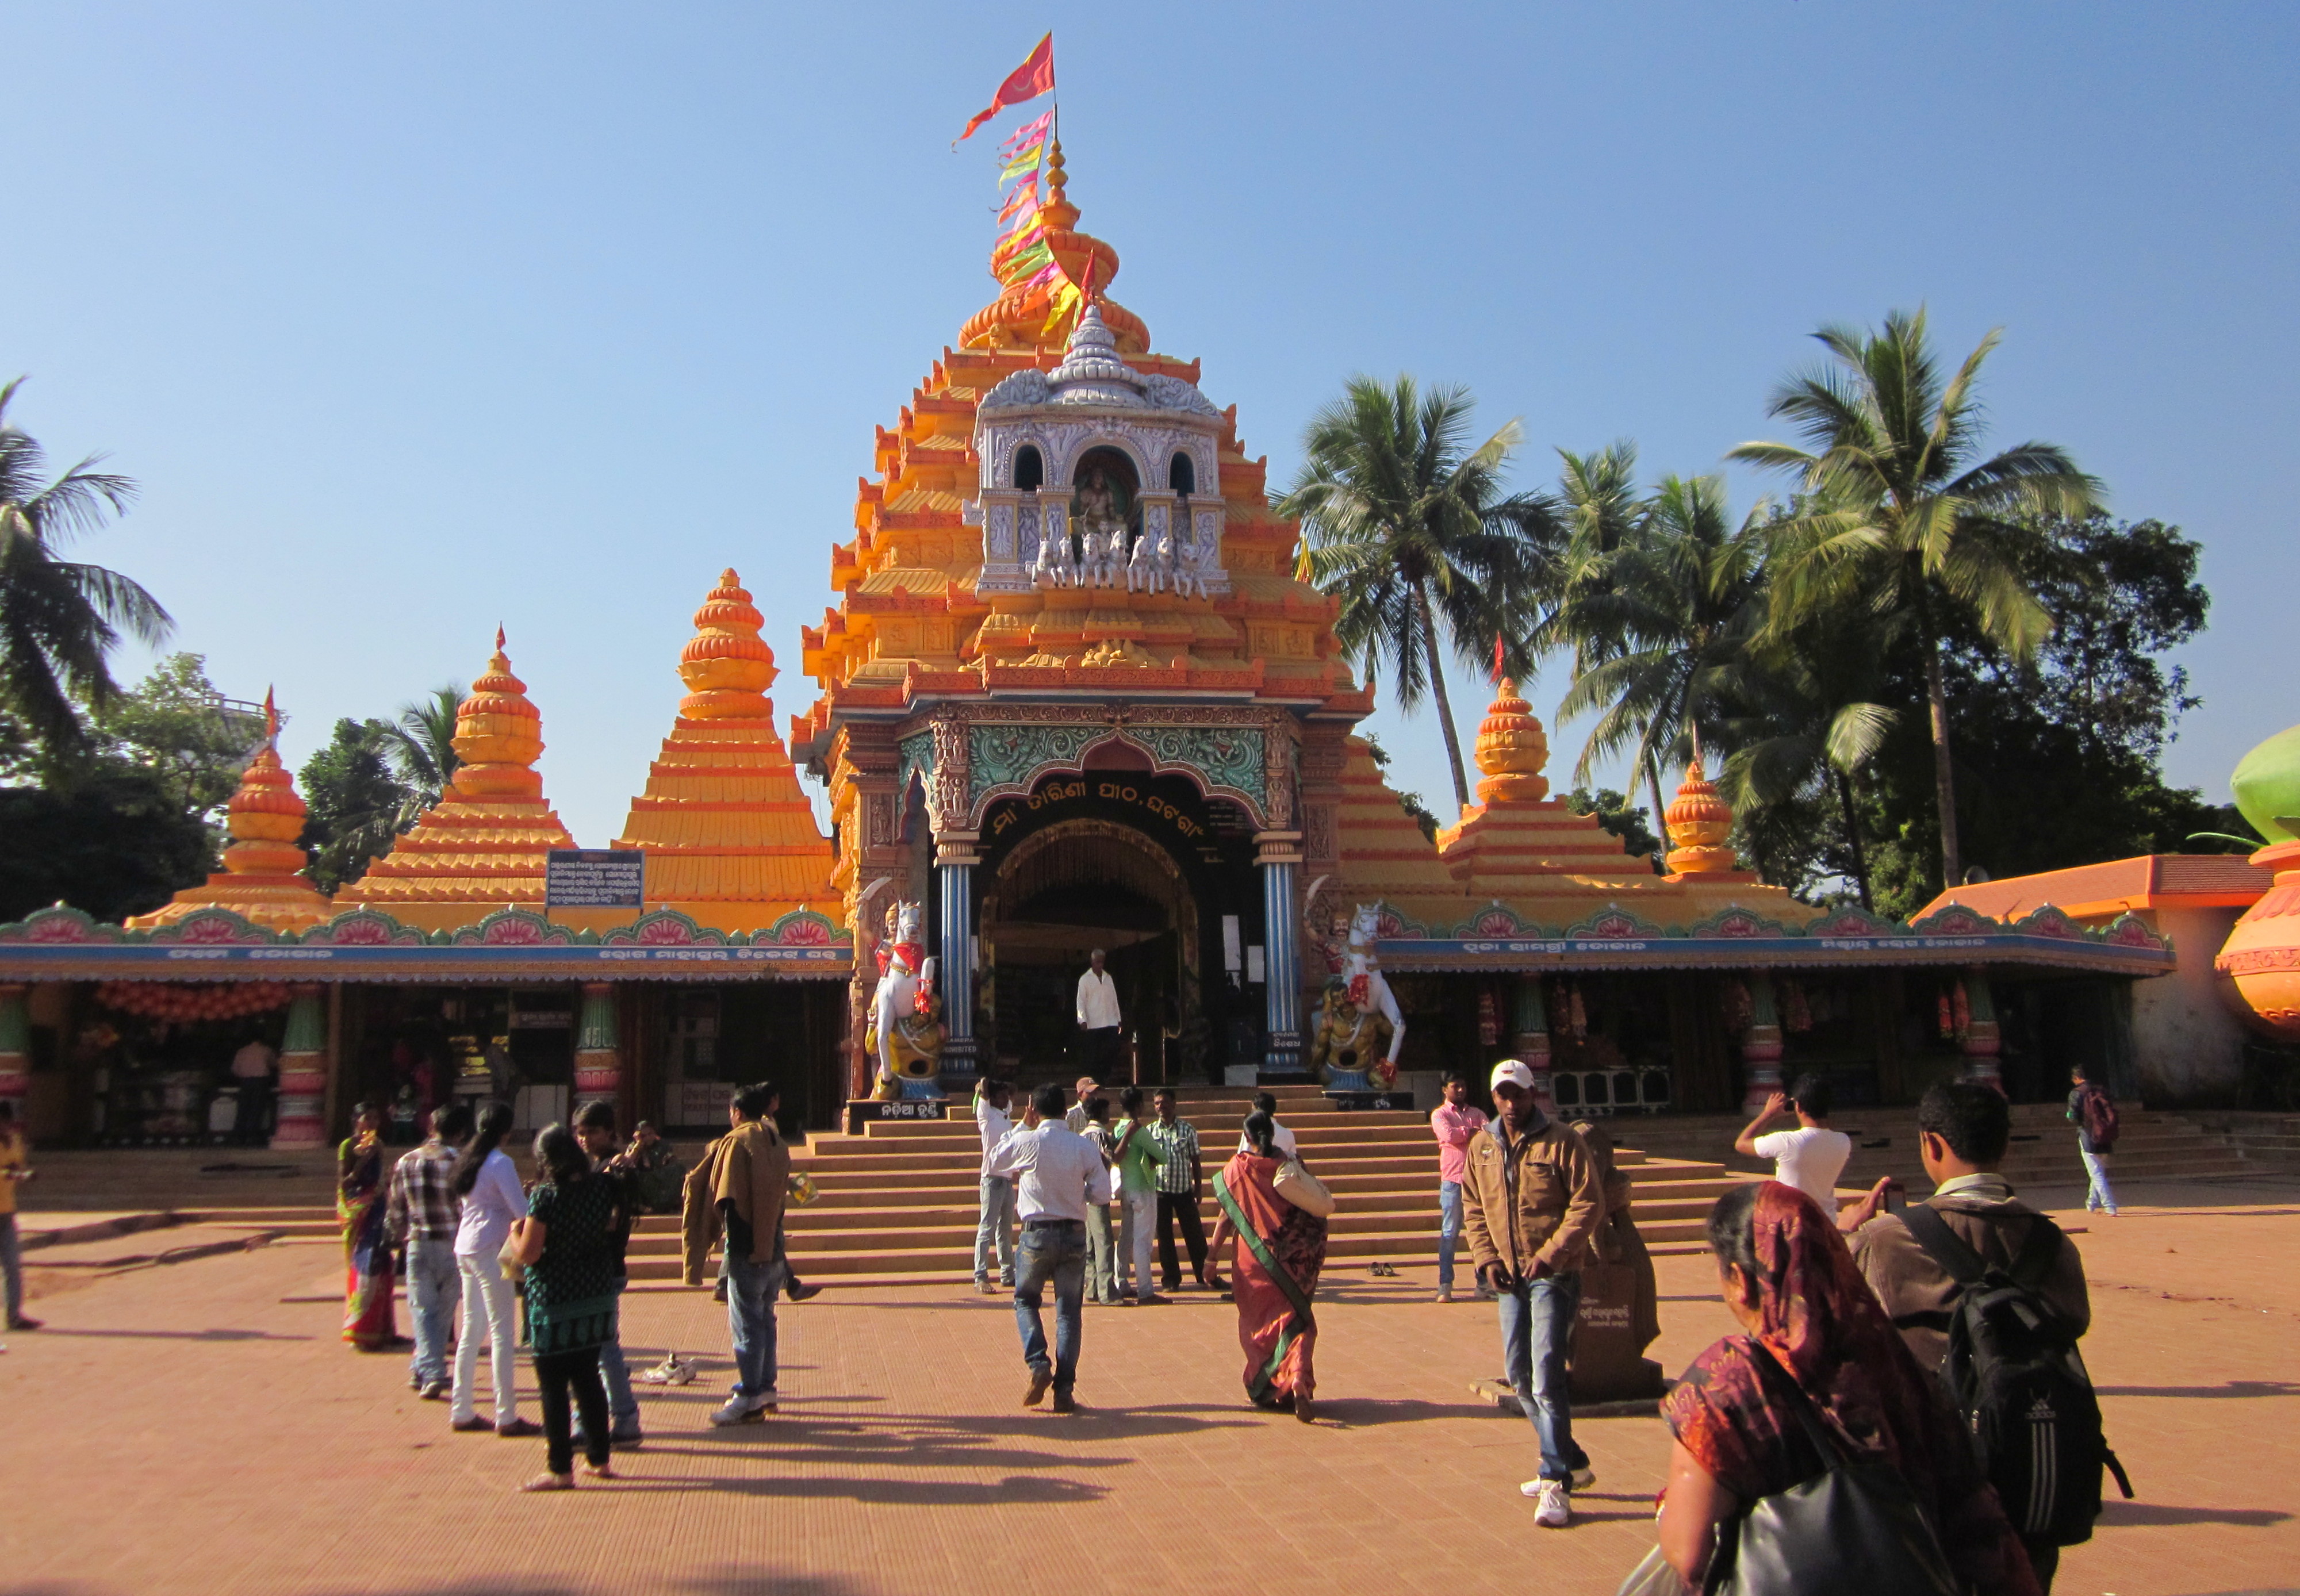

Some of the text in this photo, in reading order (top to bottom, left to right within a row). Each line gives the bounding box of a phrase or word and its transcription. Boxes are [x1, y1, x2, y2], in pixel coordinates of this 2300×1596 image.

[1027, 781, 1086, 809] ତାରିଣୀ
[1462, 943, 1499, 954] ପୂଜା
[1575, 942, 1646, 951] ଦୋକାନ
[2025, 1410, 2056, 1419] adidas
